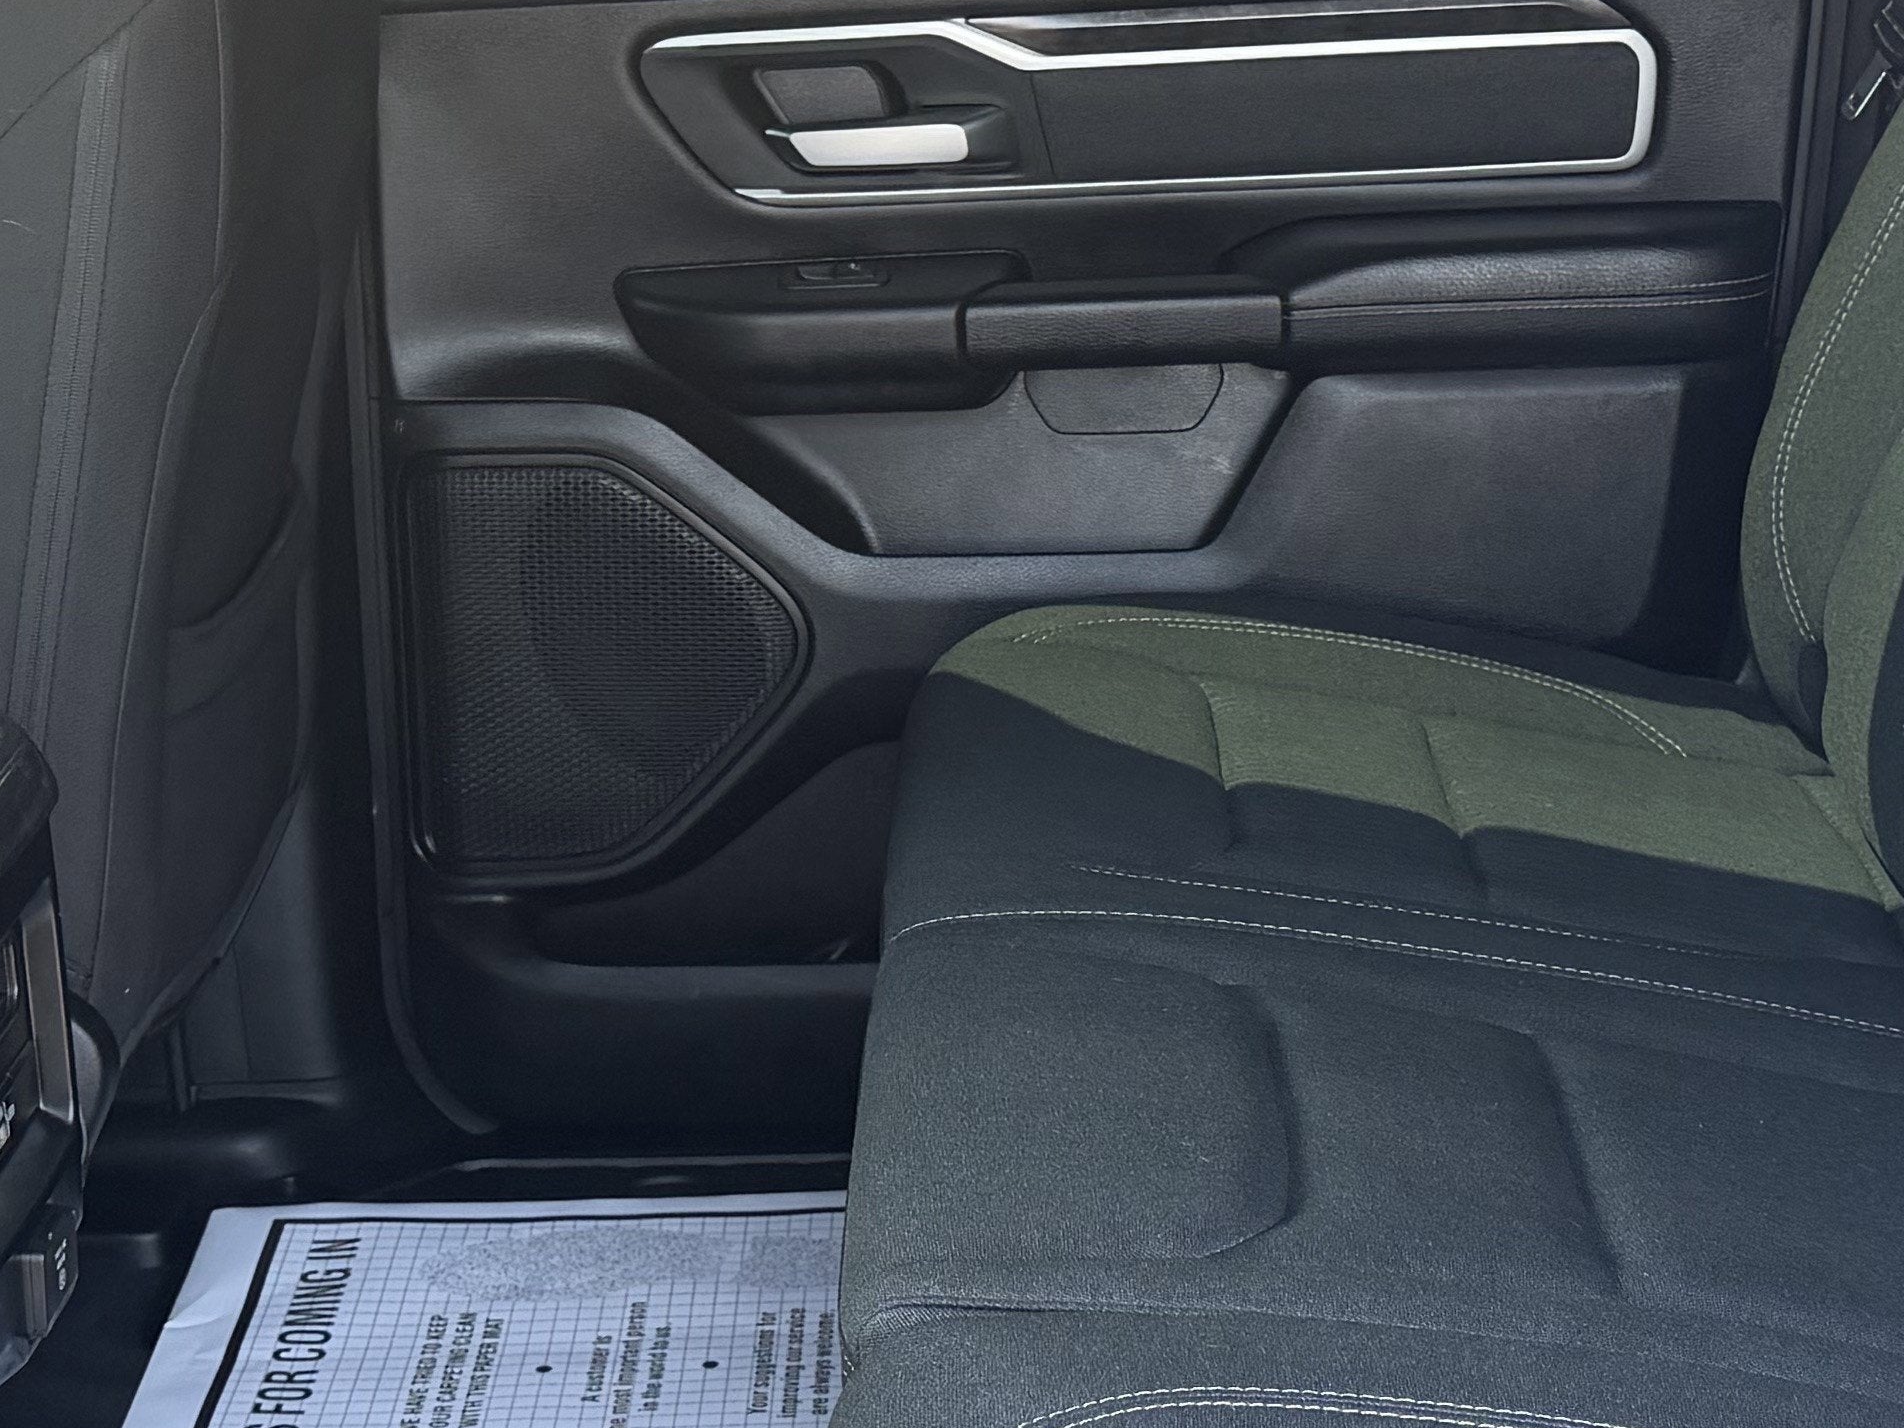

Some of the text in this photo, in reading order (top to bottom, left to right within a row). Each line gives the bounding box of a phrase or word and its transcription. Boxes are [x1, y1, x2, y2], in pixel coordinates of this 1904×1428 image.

[307, 1238, 362, 1260] IN
[271, 1267, 353, 1362] COMING
[425, 1314, 448, 1340] KEEP
[452, 1312, 477, 1346] CLEAN
[626, 1301, 648, 1337] person
[420, 1342, 442, 1355] TO
[613, 1339, 643, 1386] important
[746, 1311, 777, 1415] Your suggestions for
[411, 1357, 438, 1385] TRIED
[436, 1348, 469, 1403] CARPETING
[457, 1318, 504, 1428] WITH THIS PAPER MAT
[580, 1335, 612, 1403] A customer is
[250, 1370, 320, 1414] FOR
[403, 1387, 429, 1415] HAVE
[612, 1388, 632, 1415] most
[637, 1401, 659, 1412] in
[641, 1383, 663, 1399] the
[776, 1365, 805, 1419] improving
[811, 1397, 829, 1415] are
